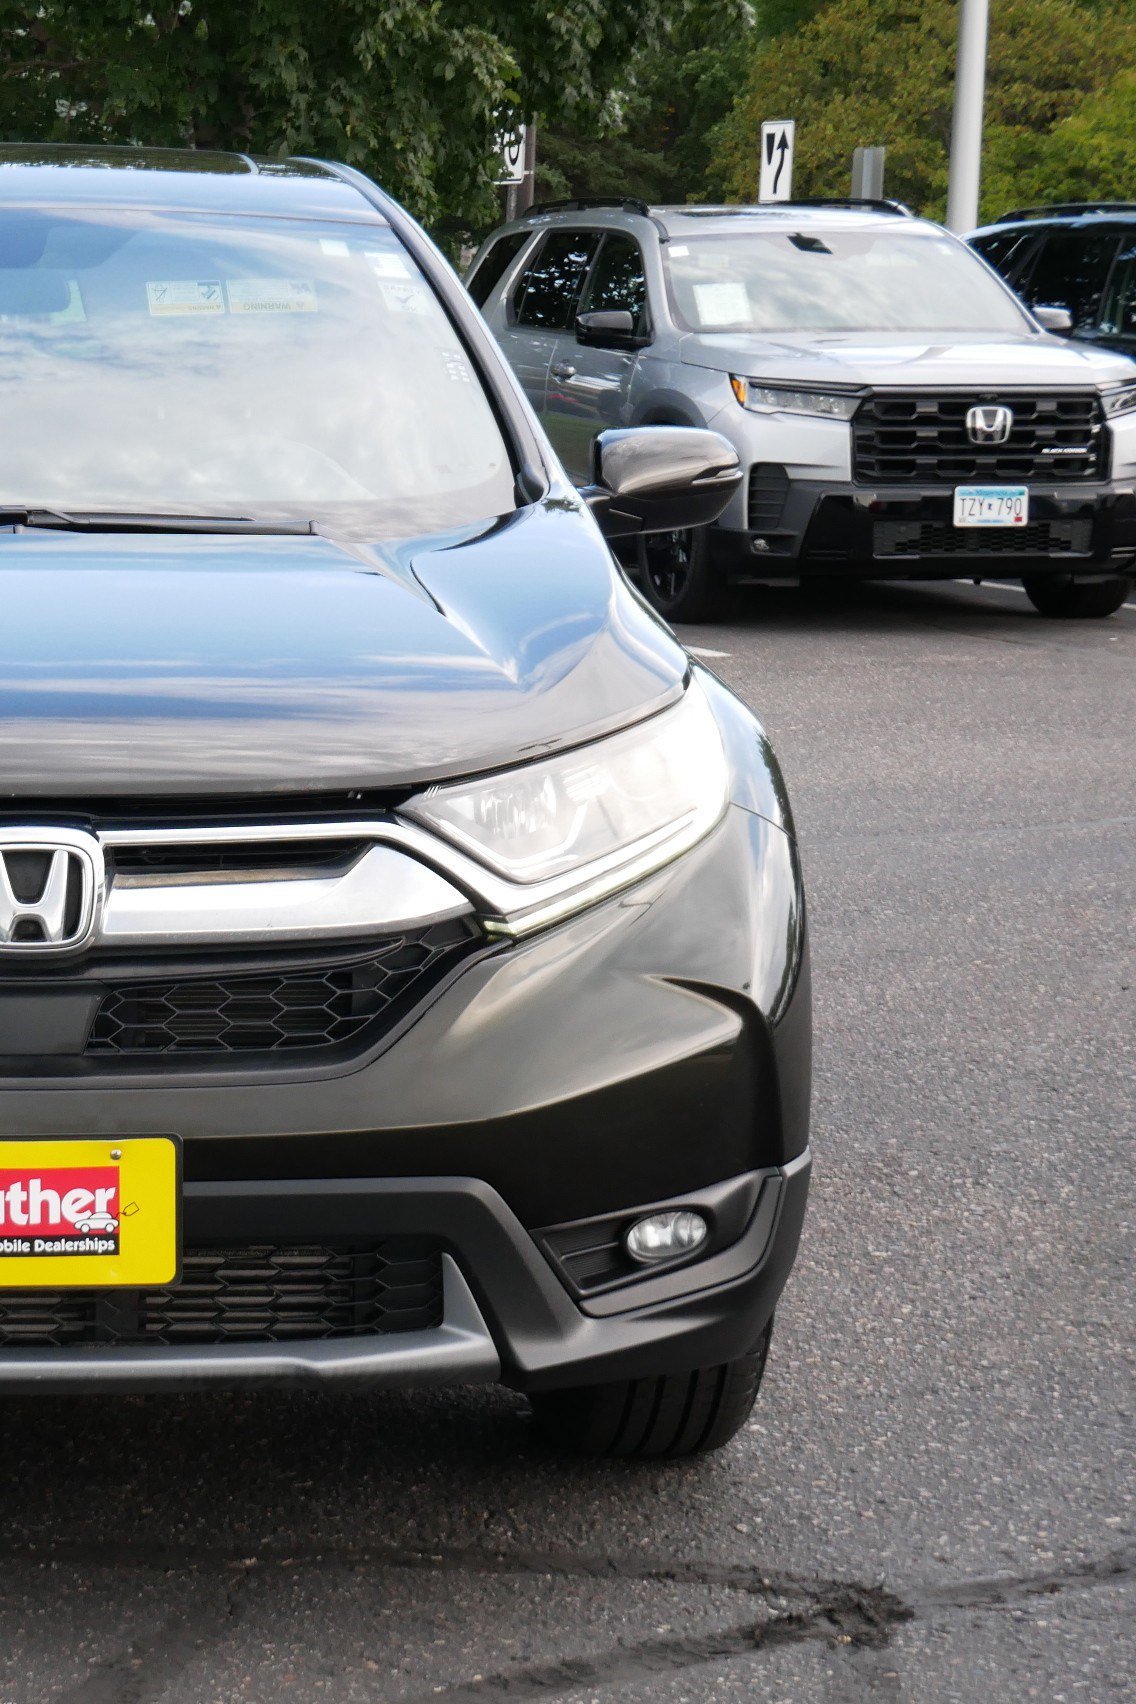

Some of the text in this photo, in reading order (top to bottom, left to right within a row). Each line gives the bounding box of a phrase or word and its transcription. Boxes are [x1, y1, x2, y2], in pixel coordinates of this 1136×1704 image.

[960, 497, 1022, 516] TZY 790
[34, 1237, 115, 1254] Dealerships
